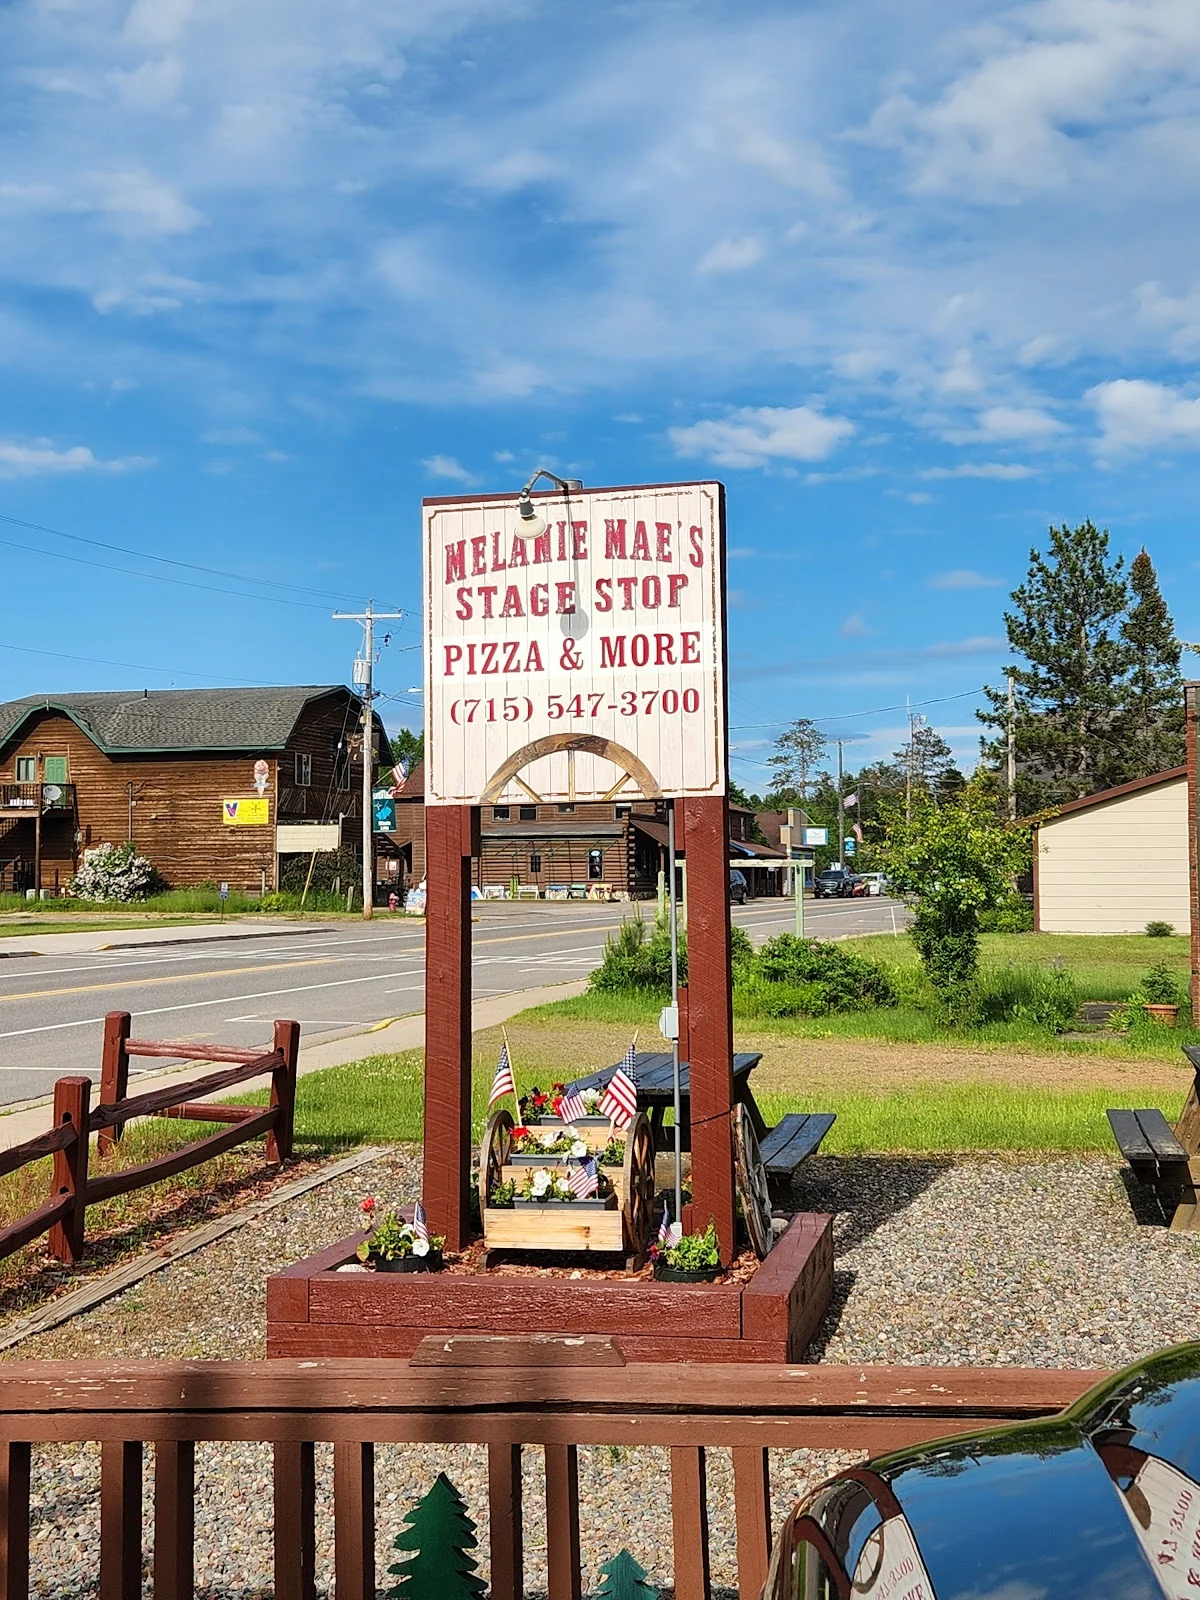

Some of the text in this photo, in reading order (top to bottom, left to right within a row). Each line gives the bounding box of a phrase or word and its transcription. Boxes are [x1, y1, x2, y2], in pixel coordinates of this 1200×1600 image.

[444, 518, 704, 585] MELANIE MAE'S
[455, 573, 689, 621] STAGE STOP
[443, 631, 701, 676] PIZZA & MORE
[450, 687, 700, 725] (715) 547-3700
